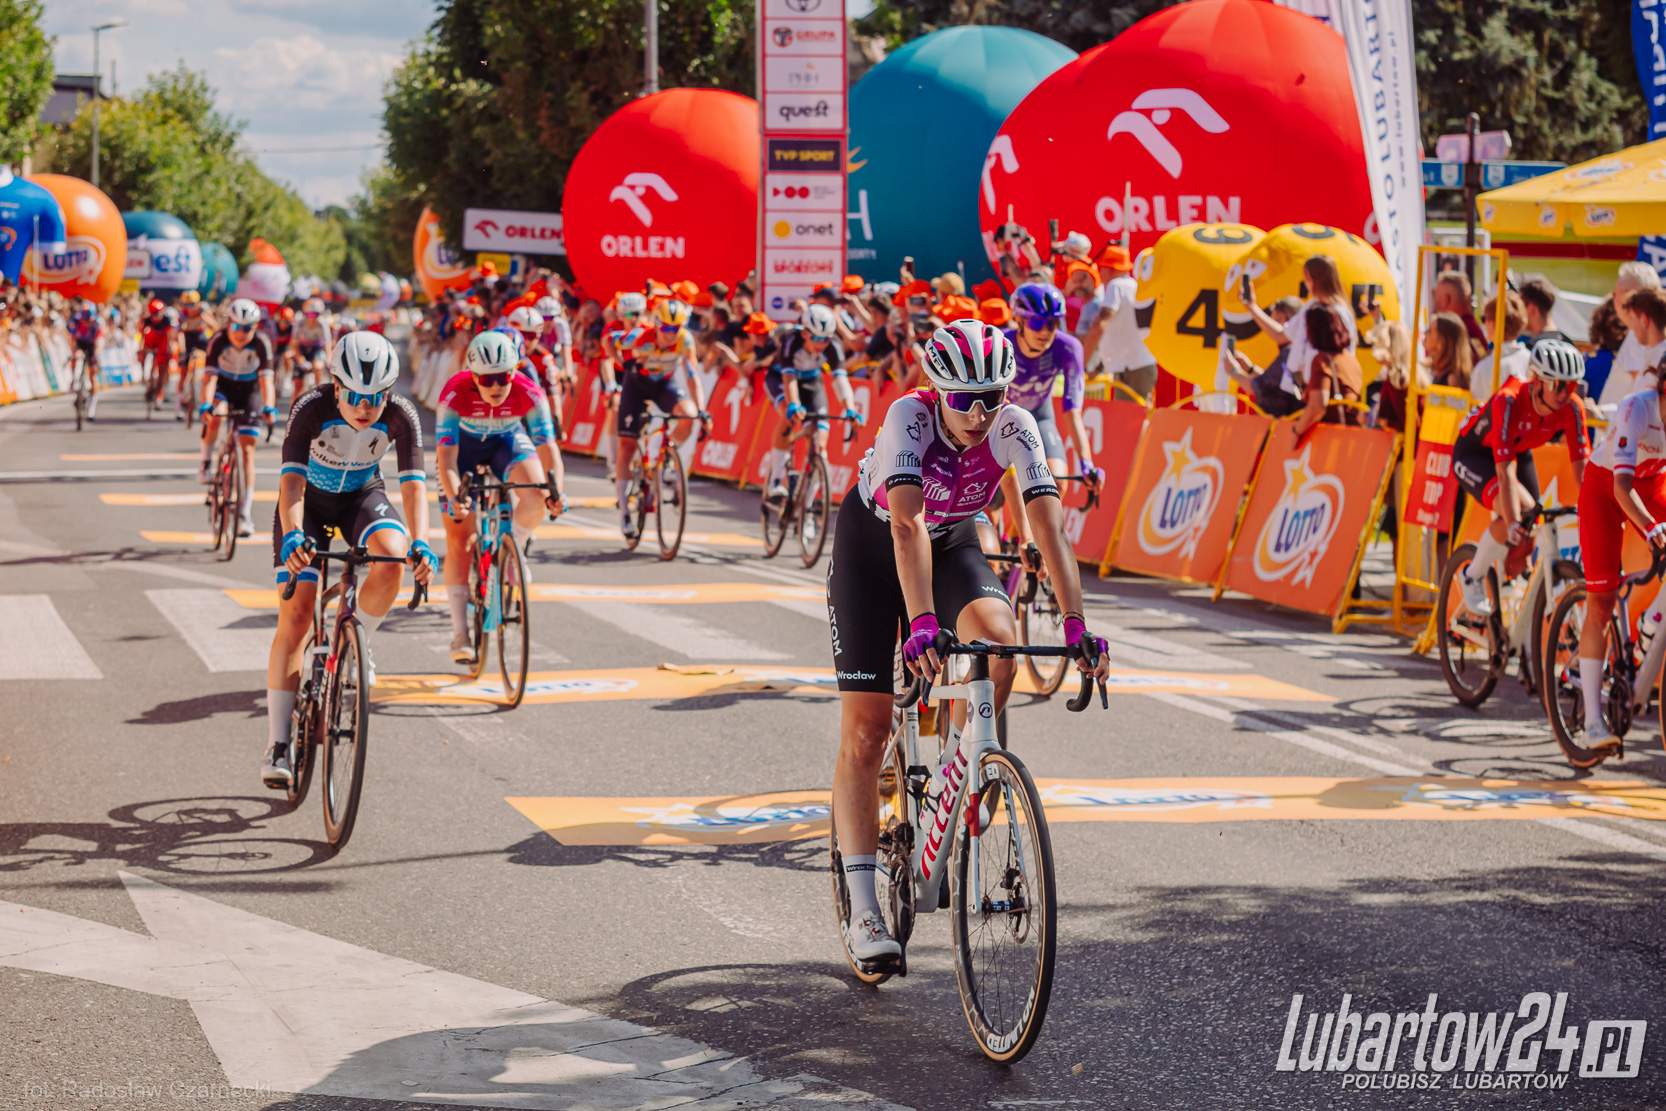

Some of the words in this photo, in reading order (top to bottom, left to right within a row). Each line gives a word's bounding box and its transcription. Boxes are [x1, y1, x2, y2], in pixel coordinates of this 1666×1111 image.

[795, 224, 833, 235] onet
[1095, 196, 1241, 233] ORLEN
[504, 225, 561, 240] ORLEN
[600, 234, 685, 259] ORLEN
[1176, 289, 1222, 348] 4
[1020, 429, 1040, 449] ATOM
[959, 491, 986, 503] ATOM
[1159, 484, 1207, 528] LOTTO
[1273, 503, 1326, 553] LOTTO
[829, 606, 843, 656] ATOM
